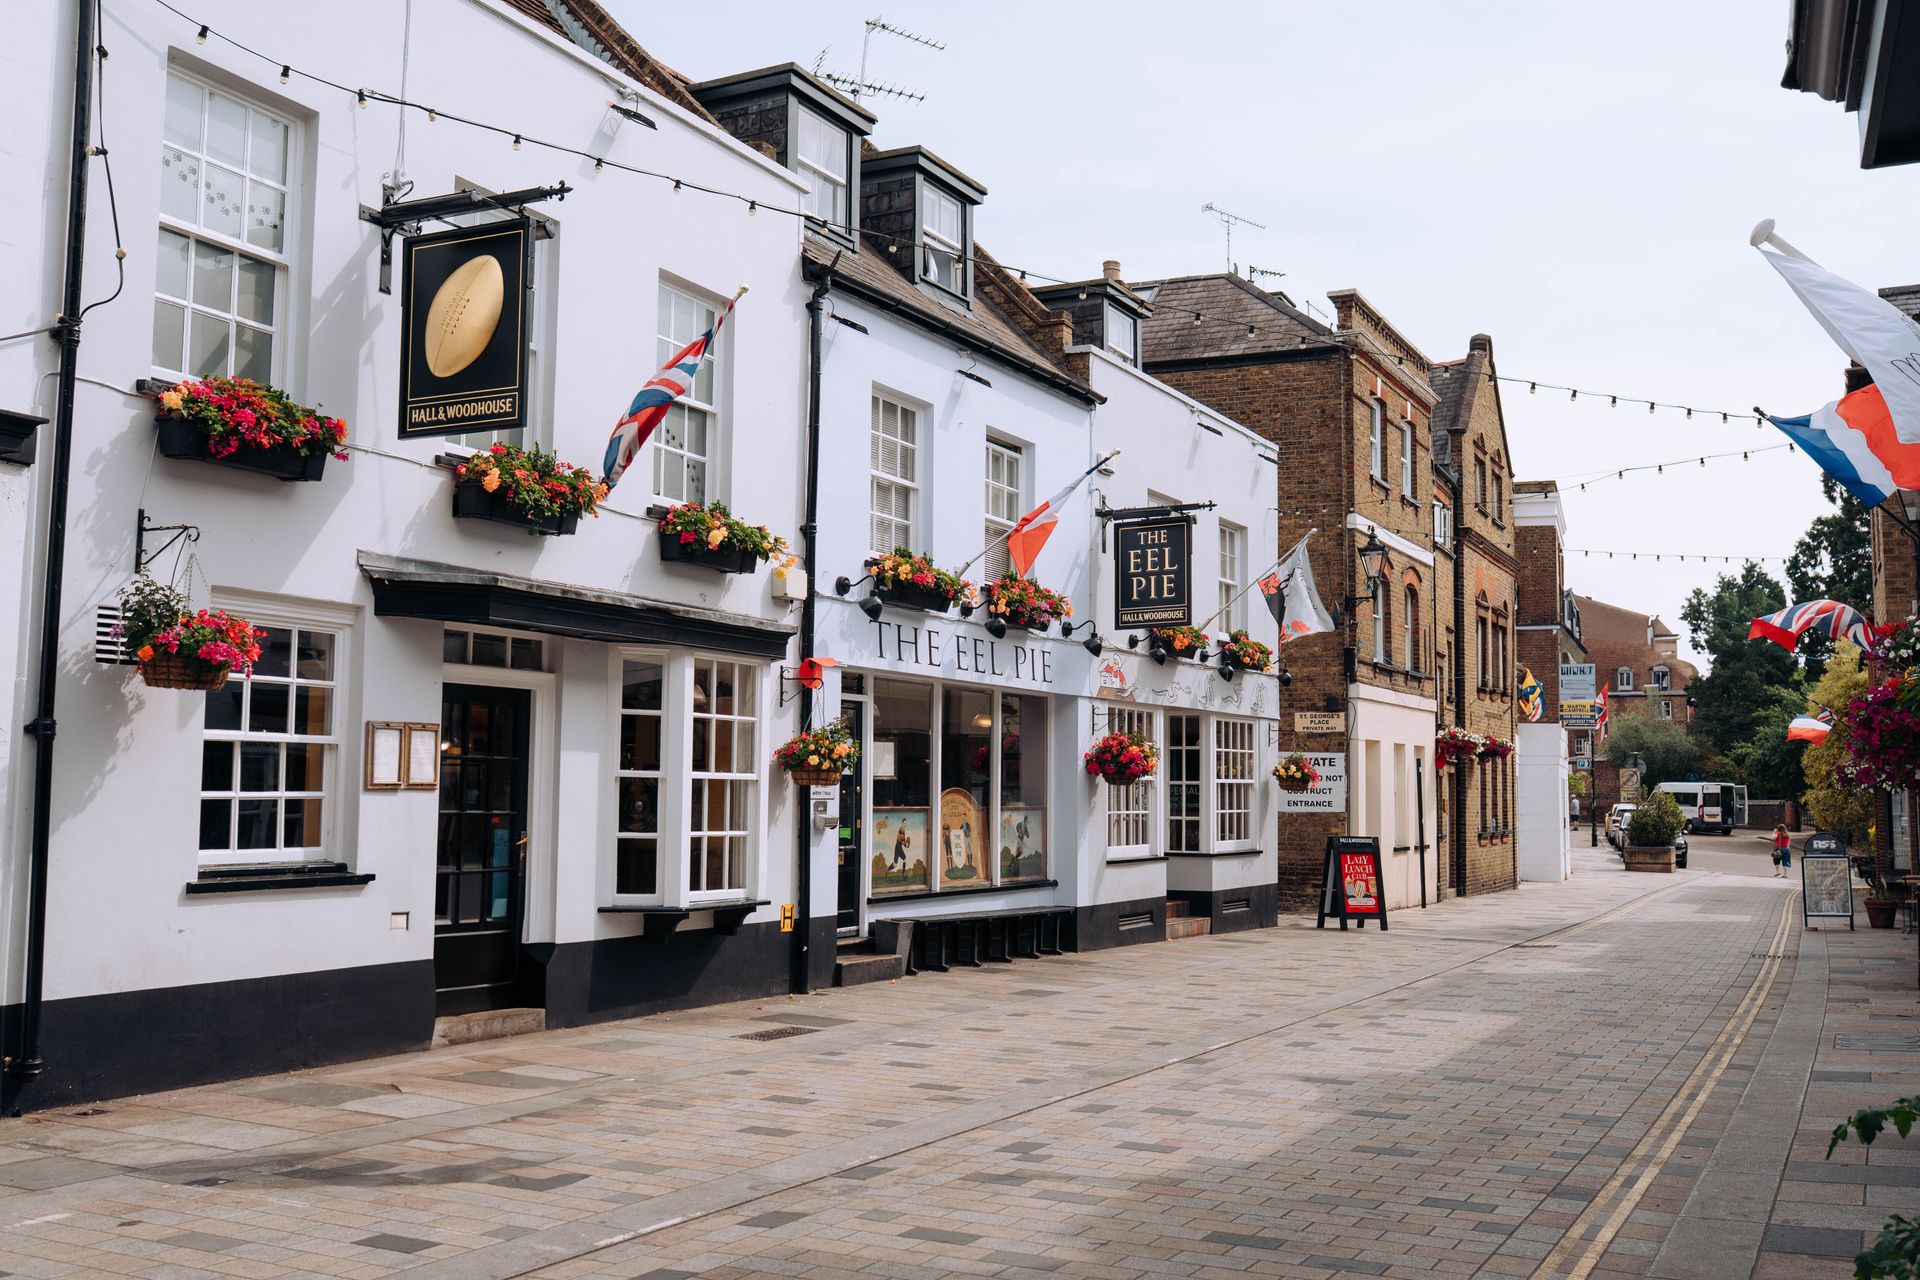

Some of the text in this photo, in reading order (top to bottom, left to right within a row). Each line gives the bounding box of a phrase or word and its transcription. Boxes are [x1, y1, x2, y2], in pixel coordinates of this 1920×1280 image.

[1137, 529, 1168, 544] THE
[1128, 547, 1178, 573] EEL
[1131, 574, 1176, 600] PIE
[869, 619, 1053, 683] THE EEL PIE
[1344, 864, 1373, 873] LUNCH
[1347, 855, 1369, 865] LAZY
[783, 906, 793, 929] H
